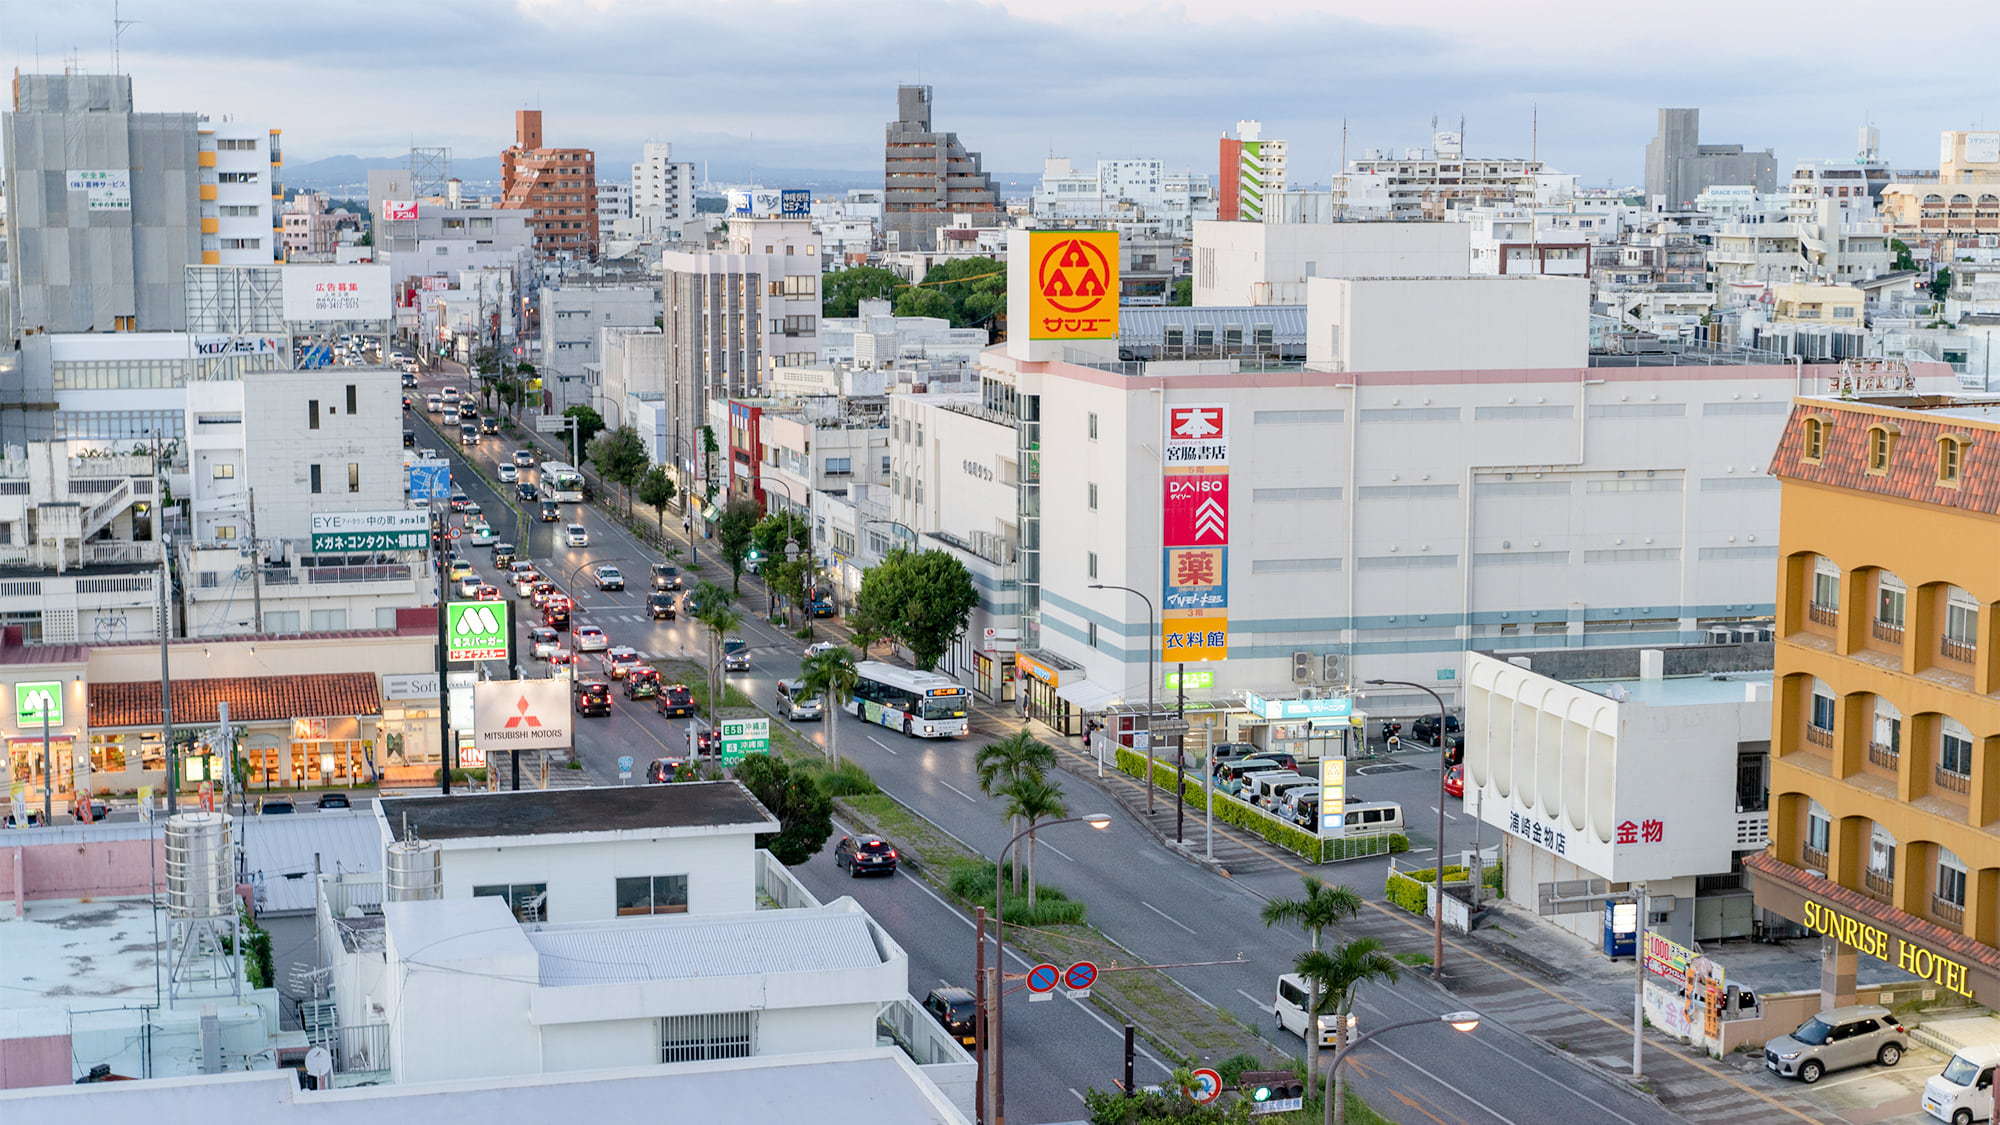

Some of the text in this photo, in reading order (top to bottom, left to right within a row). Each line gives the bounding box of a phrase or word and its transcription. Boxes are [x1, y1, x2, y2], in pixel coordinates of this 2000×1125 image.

[315, 282, 358, 292] 広告募集
[1043, 317, 1111, 332] サンエー
[1174, 408, 1220, 438] 本
[1167, 445, 1227, 461] 宮脇書店
[1170, 481, 1223, 492] DAISO
[313, 516, 341, 528] EYE
[1178, 551, 1214, 585] 薬
[453, 636, 504, 647] モスバーガー
[1166, 632, 1225, 649] 衣料館
[450, 649, 506, 660] ドライブスルー
[485, 729, 563, 741] MITSUBISHI MOTORS
[724, 726, 743, 735] E58
[1510, 810, 1566, 855] 浦崎金物店
[1616, 819, 1664, 845] 金物
[1803, 900, 1974, 999] SUNRISE HOTEL
